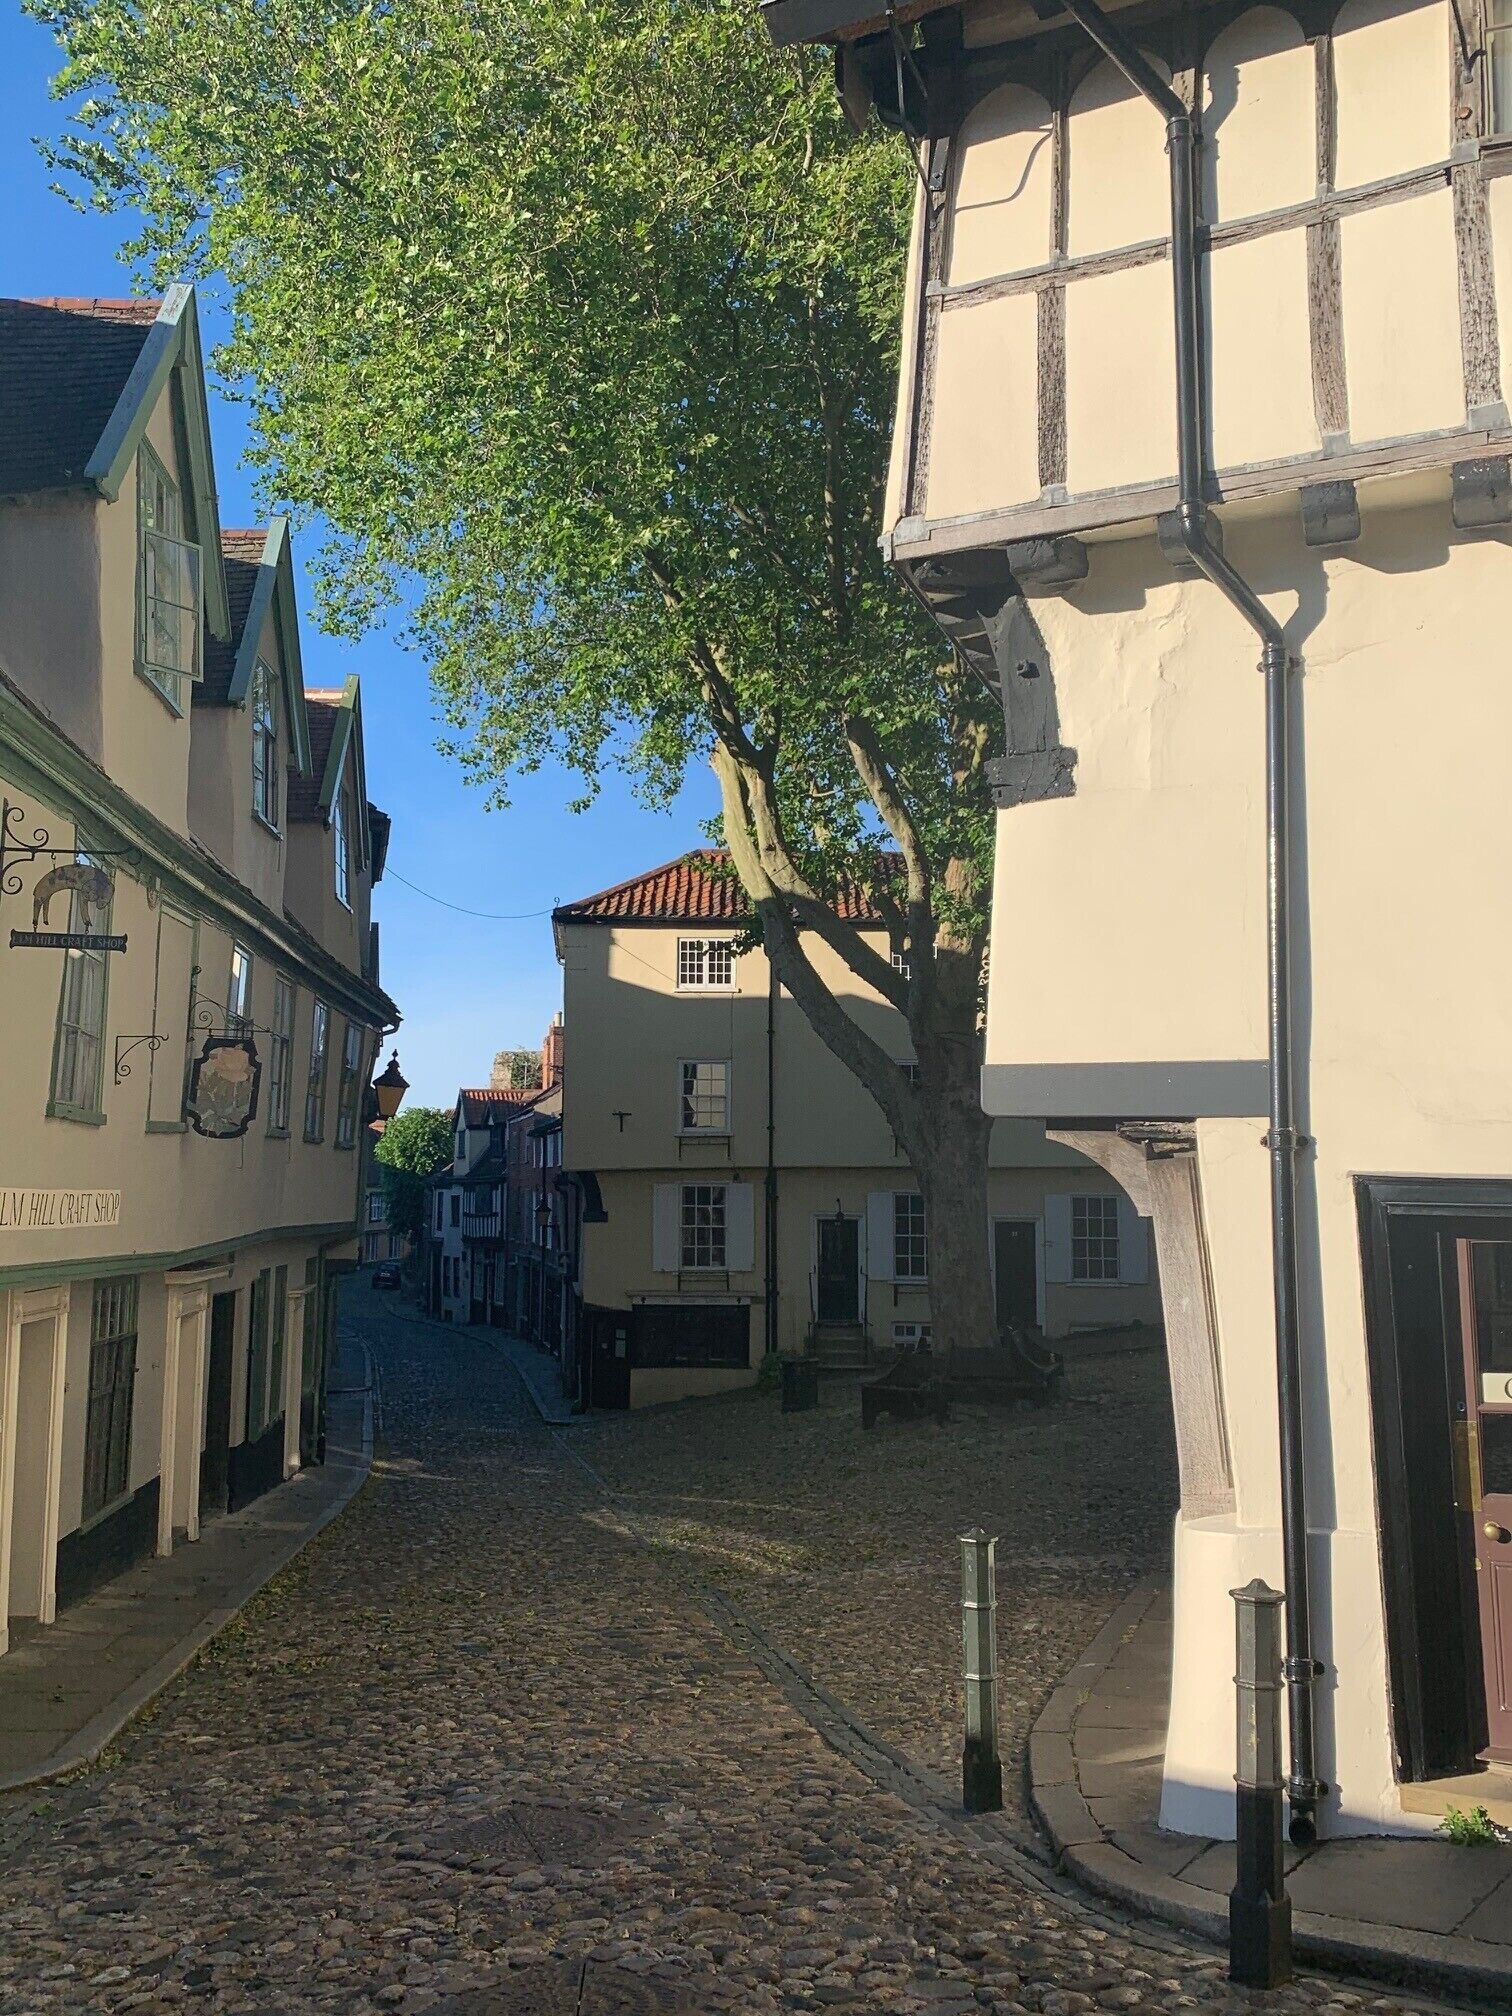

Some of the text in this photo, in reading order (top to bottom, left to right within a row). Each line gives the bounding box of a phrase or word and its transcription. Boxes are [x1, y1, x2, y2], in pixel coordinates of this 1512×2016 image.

[36, 934, 58, 945] HILL
[61, 936, 93, 947] CRAFT
[98, 938, 124, 949] SHOP
[0, 1192, 119, 1226] LM HILL CRAFT SHOP
